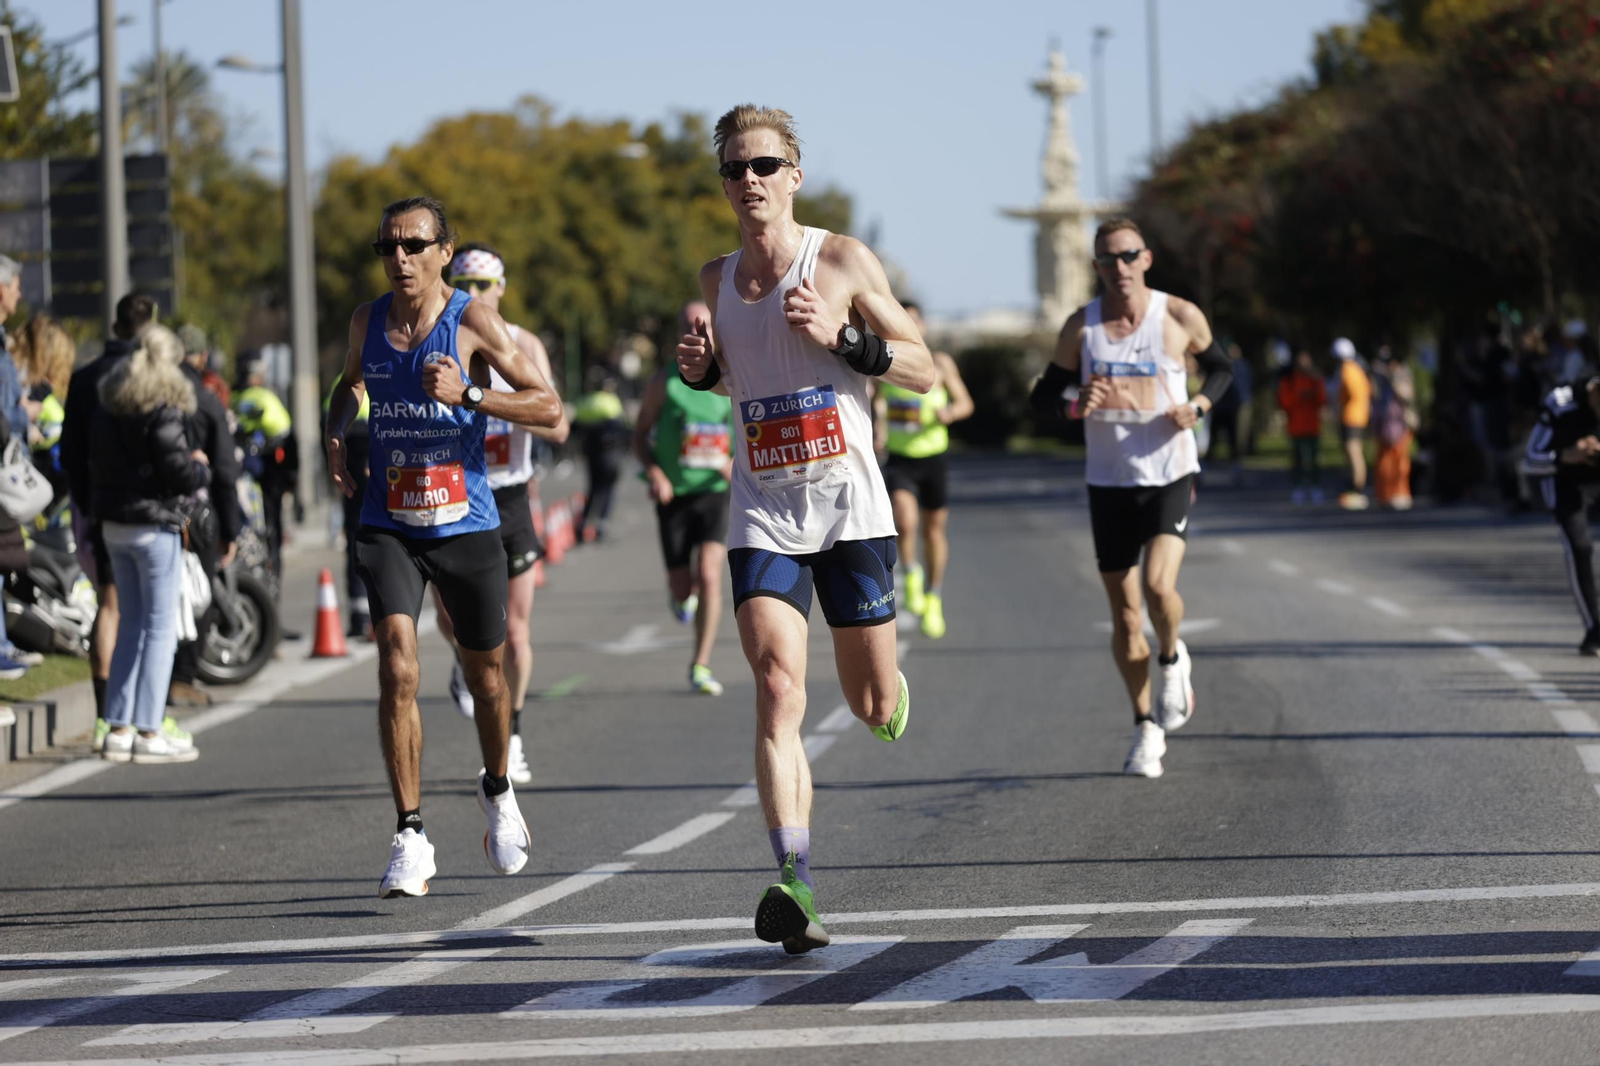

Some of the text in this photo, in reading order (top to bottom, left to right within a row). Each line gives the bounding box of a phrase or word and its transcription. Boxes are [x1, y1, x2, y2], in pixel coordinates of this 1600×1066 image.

[371, 401, 454, 419] GARMIN
[771, 393, 823, 414] ZURICH
[781, 425, 801, 439] 801
[411, 448, 451, 463] ZURICH
[753, 434, 841, 467] MATTHIEU
[416, 475, 432, 487] 660
[403, 487, 450, 507] MARIO
